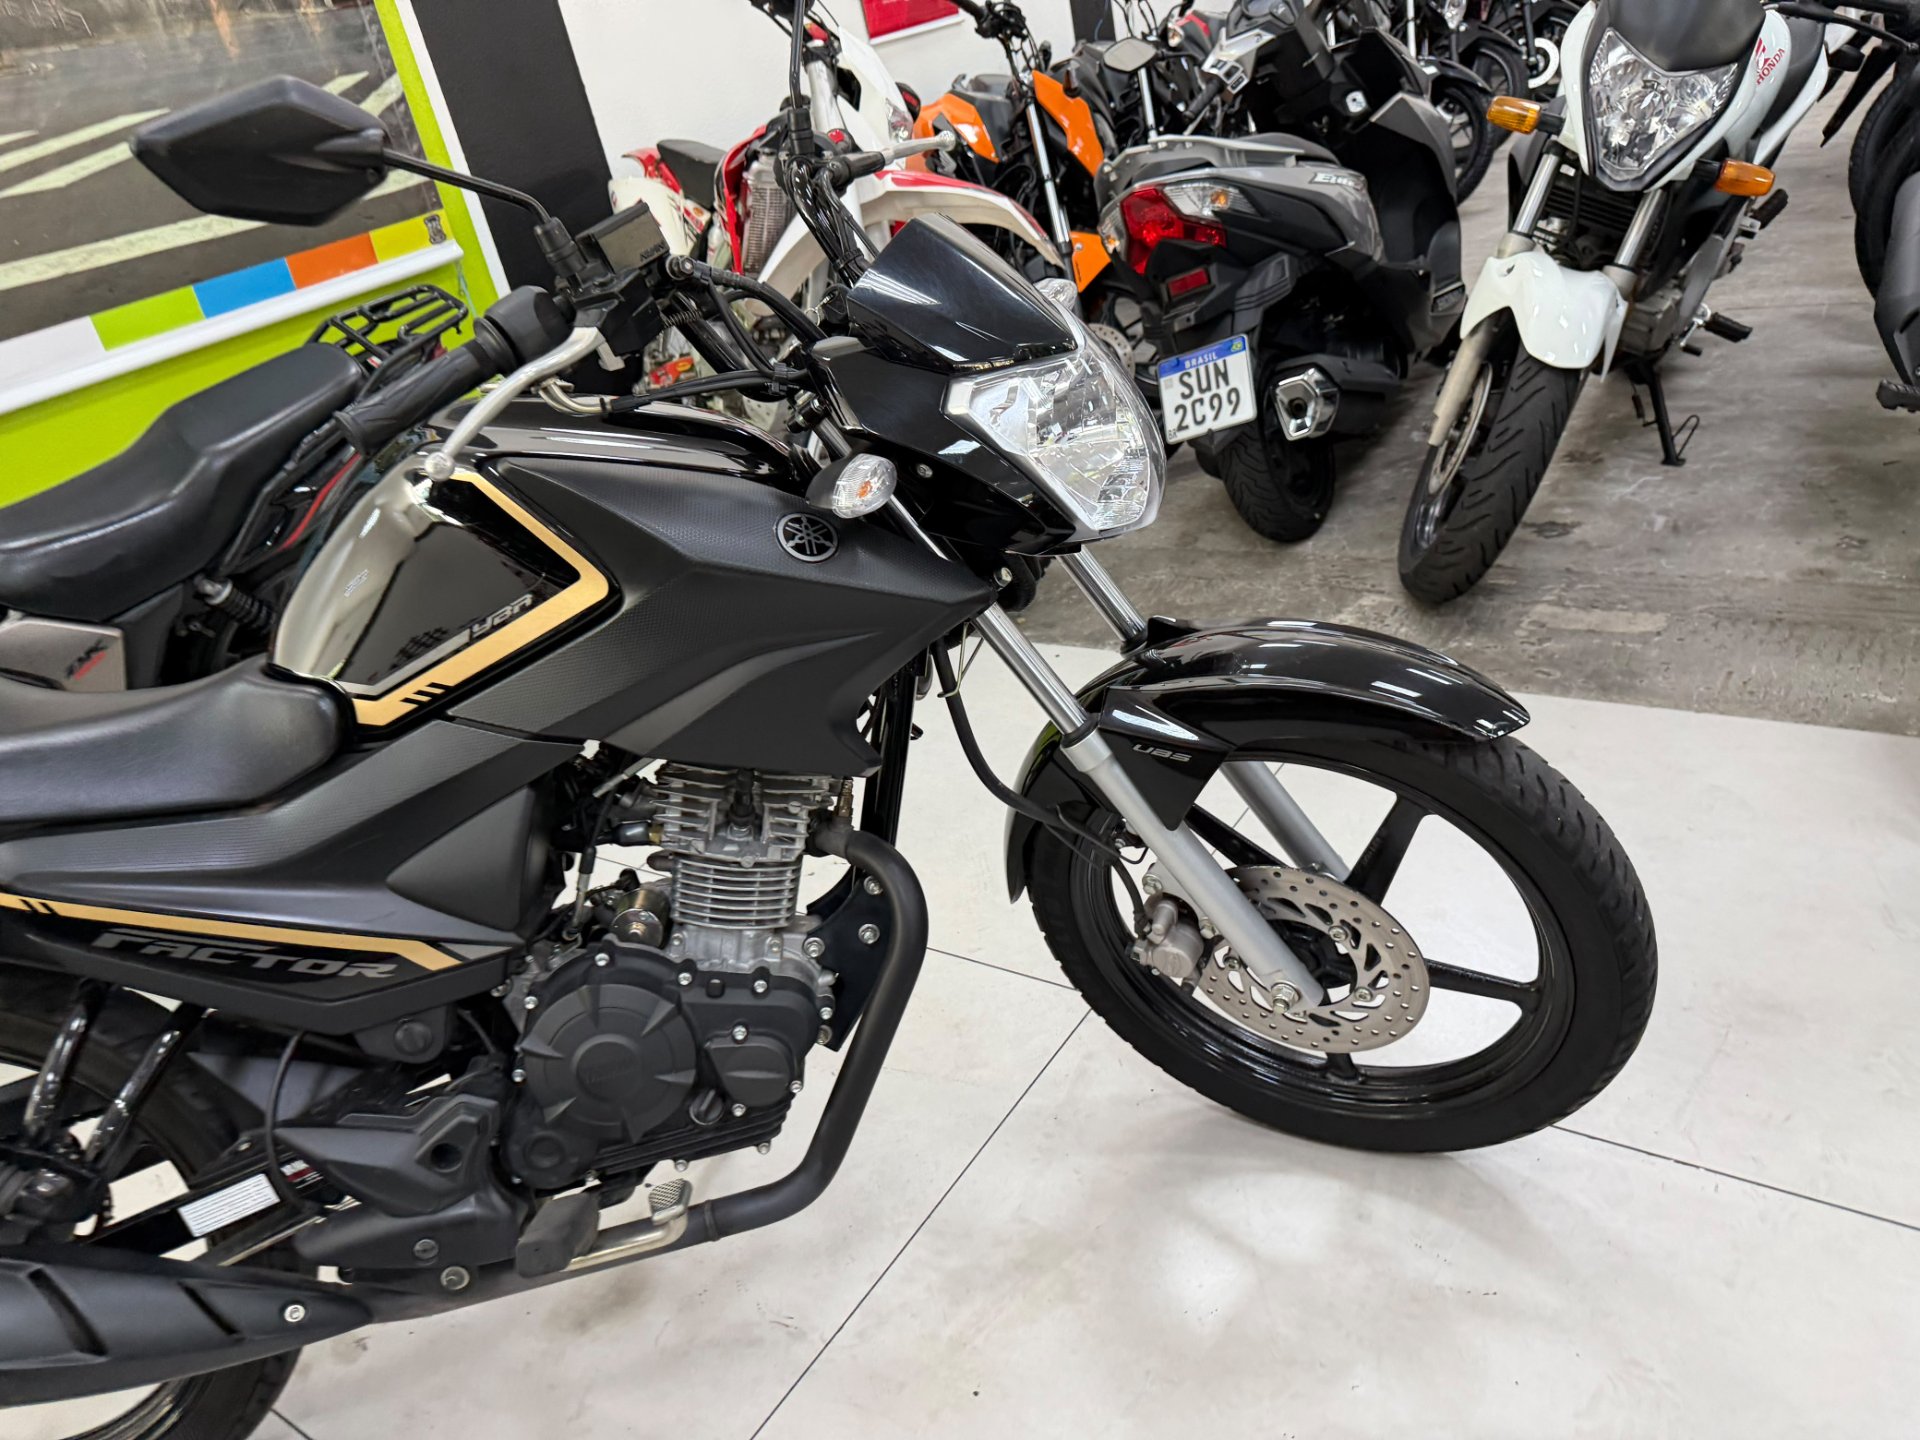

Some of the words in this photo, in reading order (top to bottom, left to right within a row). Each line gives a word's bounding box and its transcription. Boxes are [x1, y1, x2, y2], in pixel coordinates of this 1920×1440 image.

[1756, 48, 1785, 85] HONDA
[1179, 359, 1230, 400] SUN
[1184, 352, 1218, 369] BRASIL
[1174, 387, 1241, 432] 2C99
[472, 593, 534, 638] YBR
[1132, 744, 1193, 762] UBS
[91, 928, 399, 978] FACTOR
